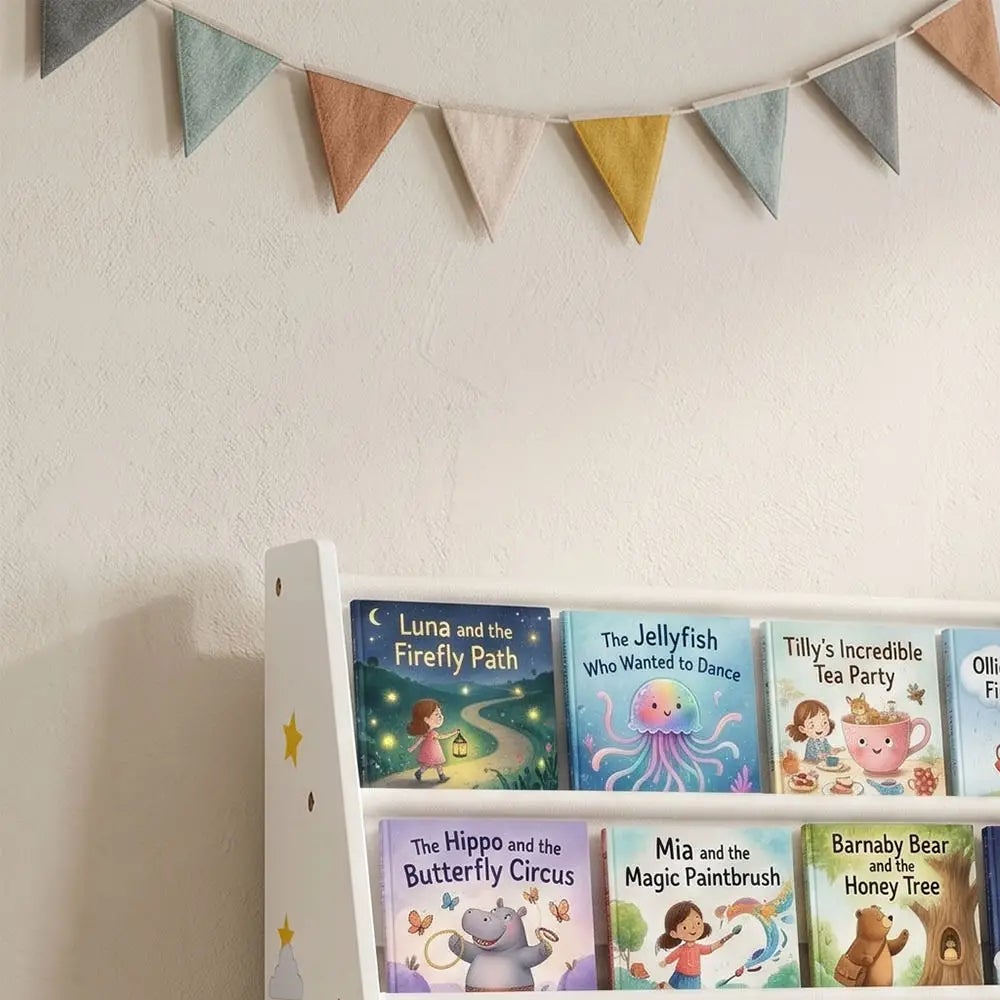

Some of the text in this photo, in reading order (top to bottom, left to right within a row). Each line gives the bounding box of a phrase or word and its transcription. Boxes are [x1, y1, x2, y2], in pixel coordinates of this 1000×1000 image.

[400, 613, 513, 639] Luna and the
[602, 624, 718, 653] The Jellyfish
[395, 643, 518, 675] Firefly Path
[783, 636, 922, 661] Tilly's Incredible
[583, 654, 741, 682] Who Wanted to Dance
[814, 664, 895, 691] Tea Party
[411, 831, 561, 856] The Hippo and the
[656, 837, 750, 861] Mia and the
[832, 834, 949, 858] Barnaby Bear
[404, 857, 574, 888] Butterfly Circus
[869, 859, 915, 873] and the
[625, 866, 780, 893] Magic Paintbrush
[845, 876, 940, 901] Honey Tree
